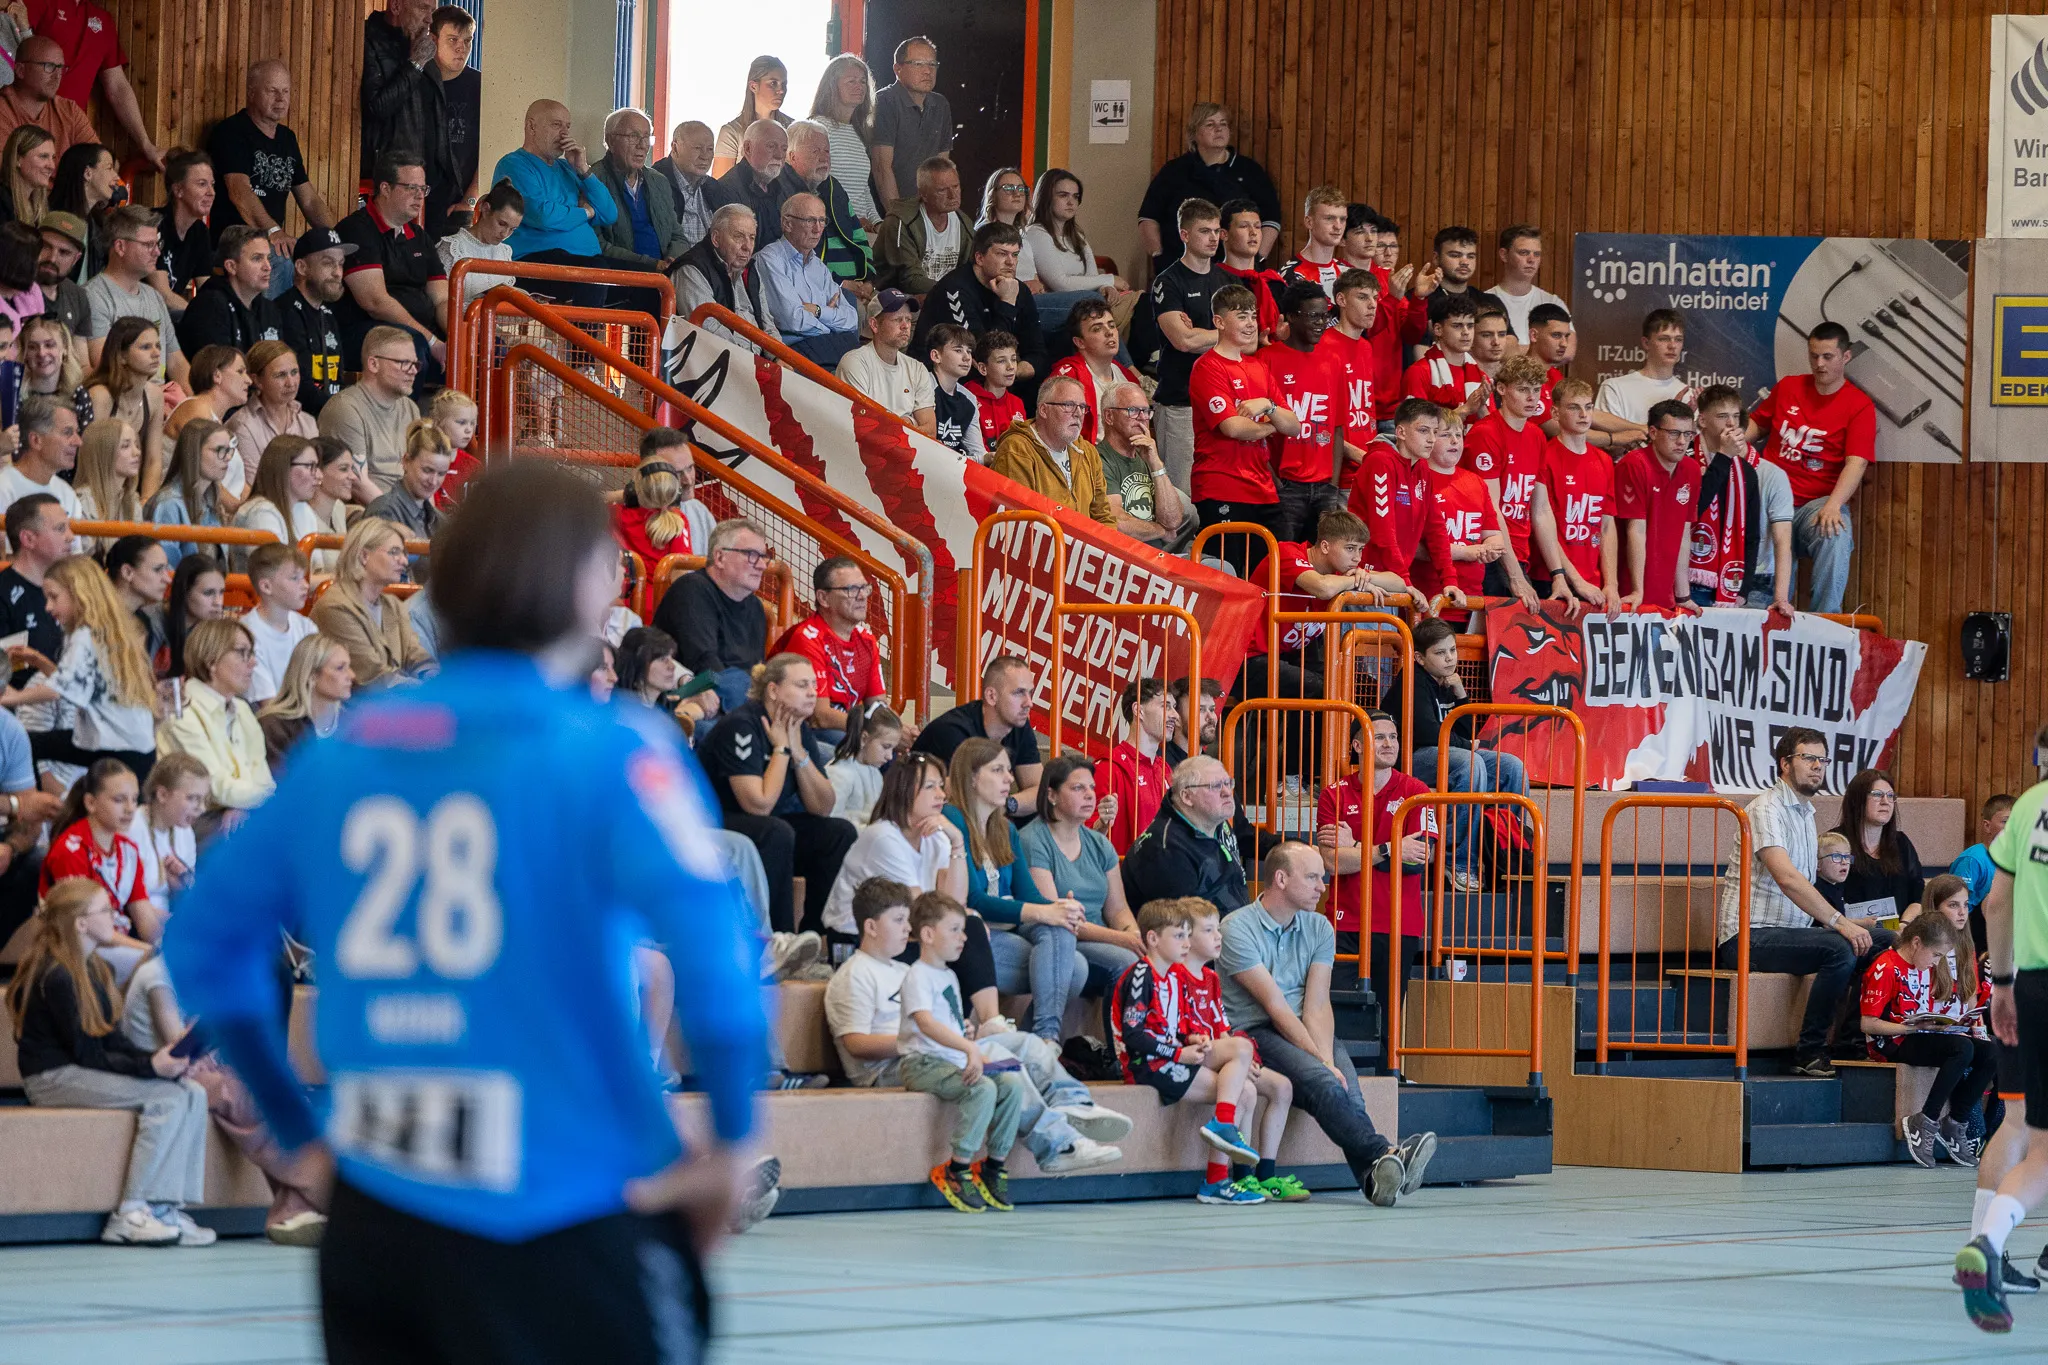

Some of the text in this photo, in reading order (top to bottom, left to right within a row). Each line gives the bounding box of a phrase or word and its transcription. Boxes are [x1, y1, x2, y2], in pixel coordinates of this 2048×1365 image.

[1094, 102, 1109, 113] WC
[1600, 242, 1770, 288] manhattan
[1669, 291, 1769, 311] verbindet
[1598, 345, 1688, 363] IT-Zubr
[1687, 371, 1744, 390] Halver
[1286, 392, 1329, 422] WE
[1779, 419, 1828, 453] WE
[1502, 473, 1537, 503] WE
[1565, 493, 1604, 523] WE
[1440, 510, 1483, 541] WE
[981, 567, 1162, 683] MITLEIDEN
[337, 793, 502, 978] 28
